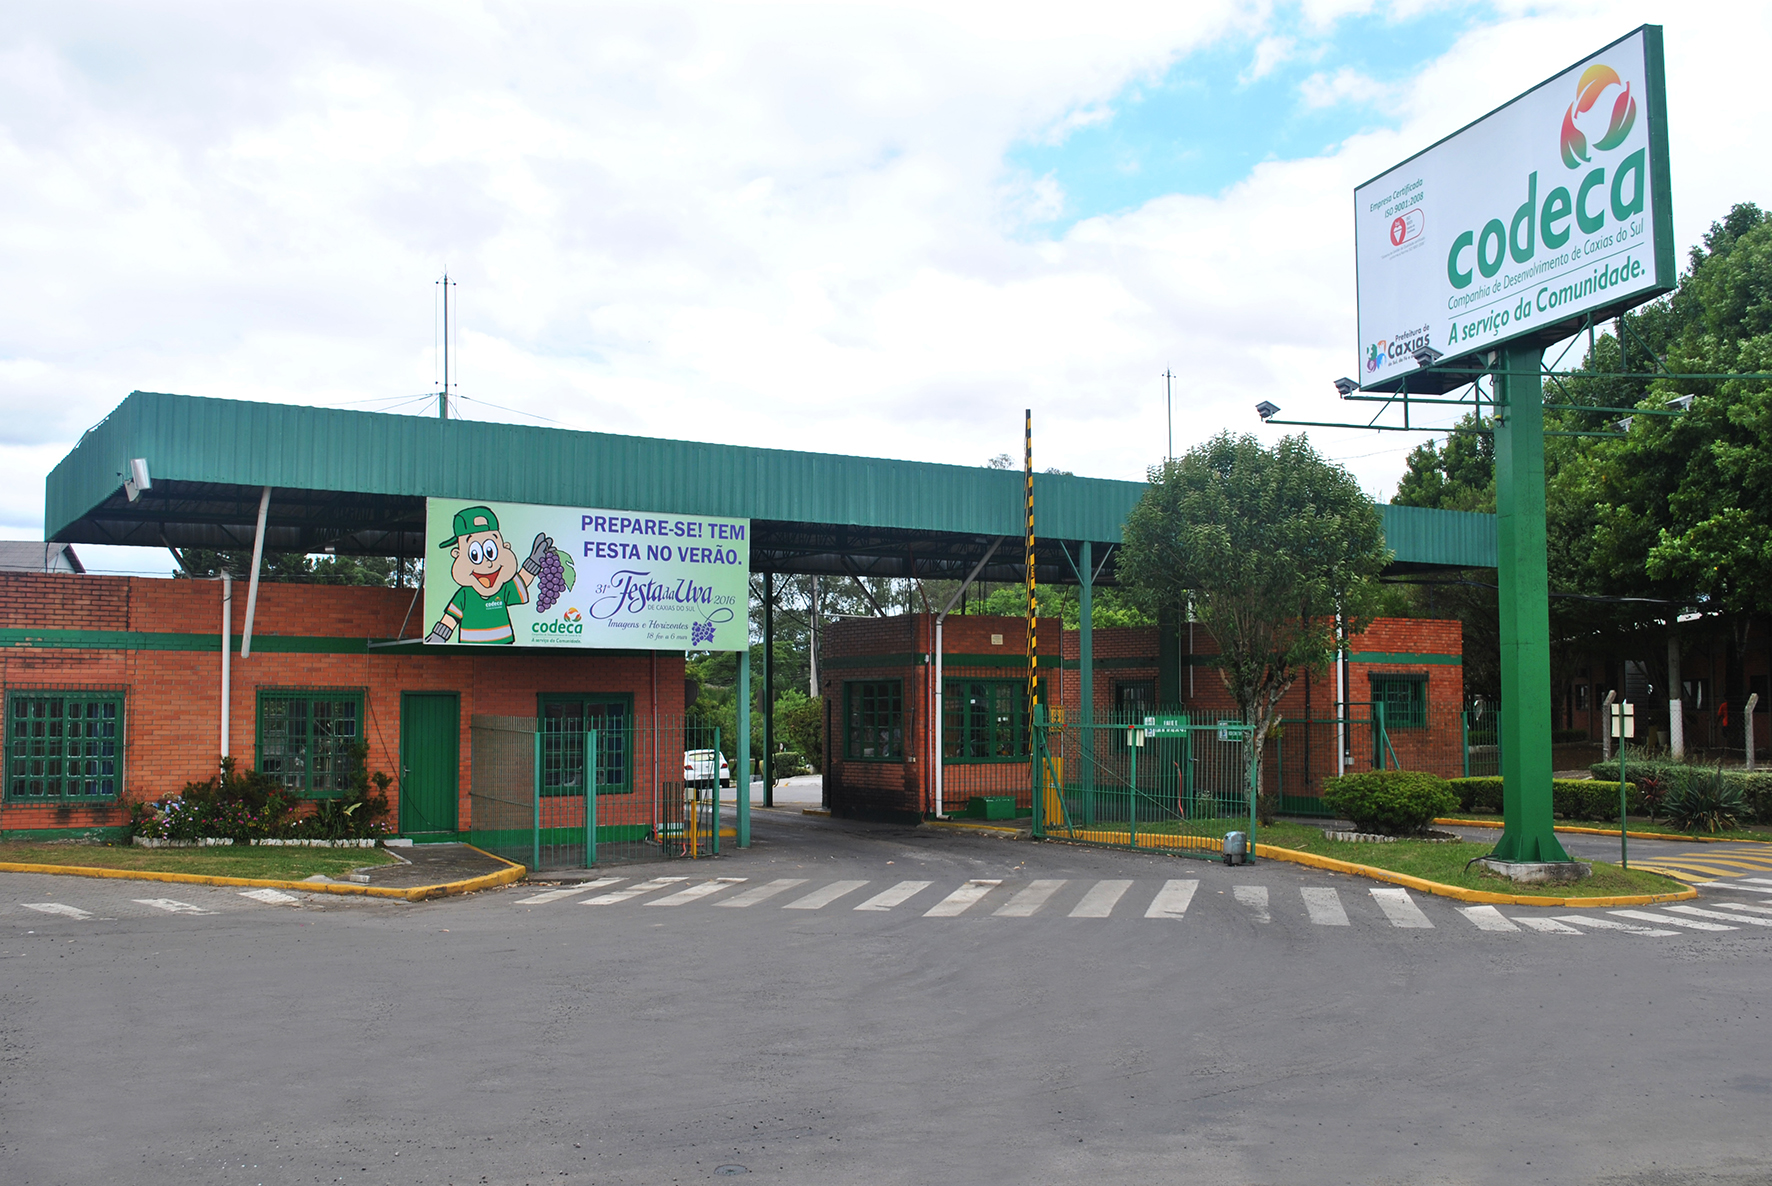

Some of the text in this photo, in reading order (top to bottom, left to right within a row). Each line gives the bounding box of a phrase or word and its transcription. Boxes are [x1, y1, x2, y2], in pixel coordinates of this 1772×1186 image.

[1370, 178, 1423, 212] Empresa Certificada
[1384, 191, 1424, 218] ISO 9001:2008
[1447, 147, 1646, 289] codeca
[1448, 217, 1644, 310] Companhia de Desenvolvimento de Caxias do Sul
[1448, 255, 1645, 346] A serviço da Comunidade.
[1395, 323, 1430, 342] Prefeitura de
[1388, 333, 1430, 359] Caxias
[581, 515, 745, 540] PREPARE-SE! TEM
[583, 541, 742, 565] FESTA NO VERÃO.
[590, 570, 663, 619] Festa
[662, 586, 675, 601] da
[675, 578, 713, 604] Uva
[713, 595, 736, 605] 2016
[531, 618, 583, 634] codeca
[608, 619, 640, 631] Imagens
[648, 620, 689, 630] Horizontes
